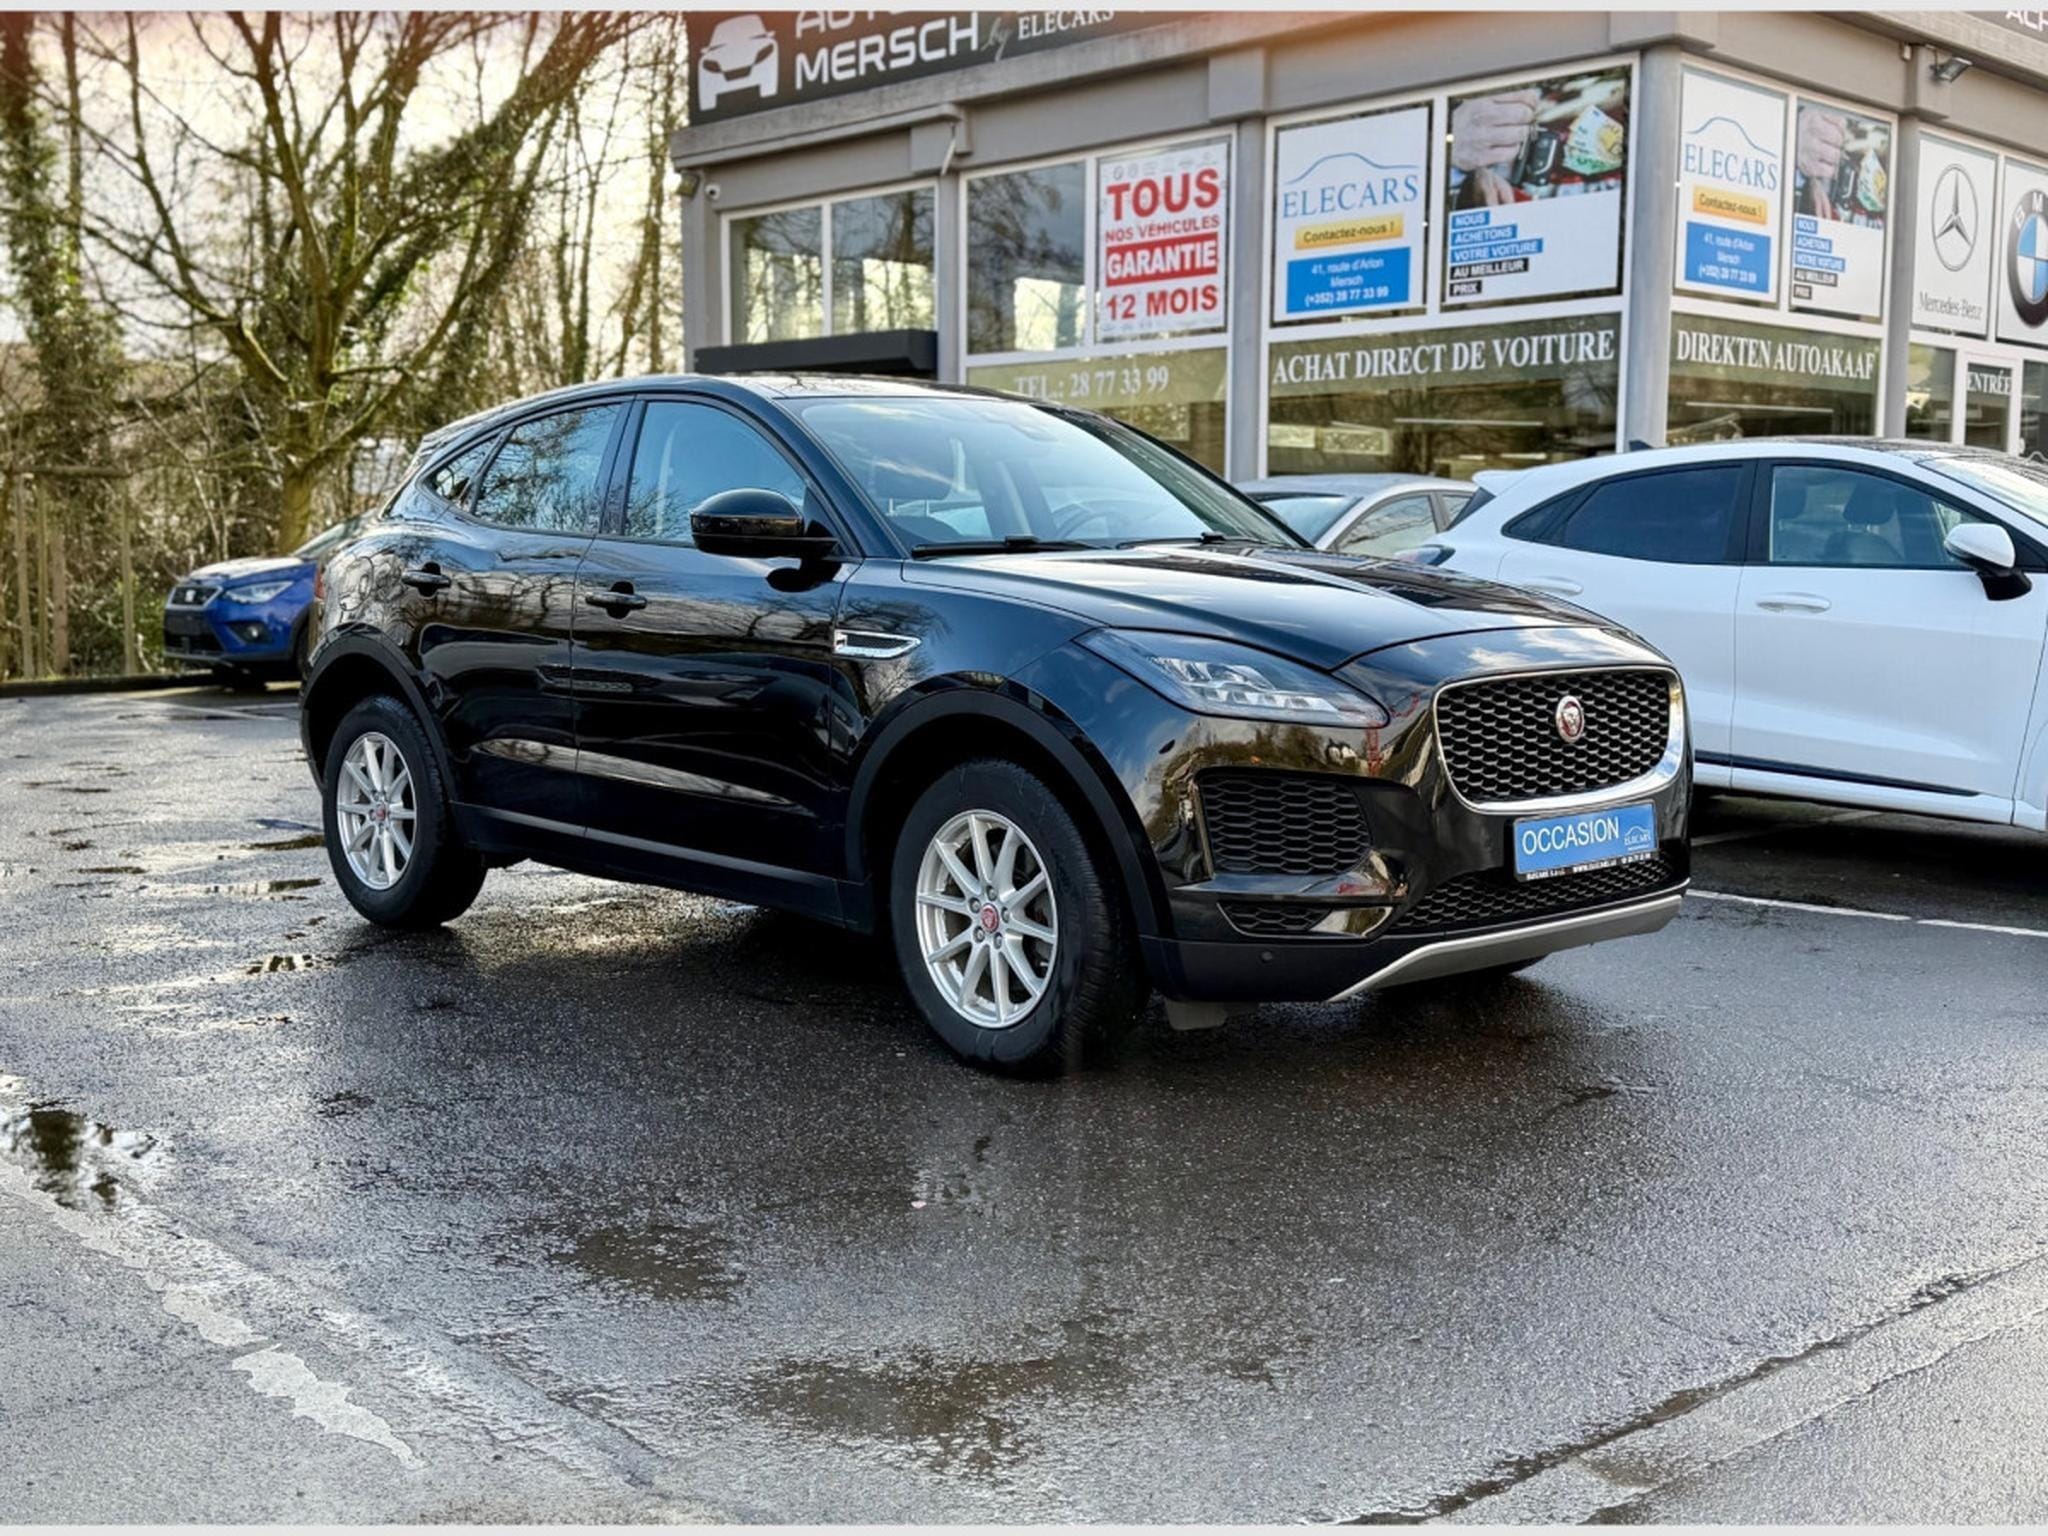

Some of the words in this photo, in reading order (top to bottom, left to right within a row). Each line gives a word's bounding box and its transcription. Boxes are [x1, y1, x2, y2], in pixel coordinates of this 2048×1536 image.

[796, 11, 906, 38] AU
[795, 11, 978, 90] MERSCH
[1684, 143, 1778, 191] ELECARS
[1106, 168, 1220, 221] TOUS
[1283, 174, 1419, 218] ELECARS
[1105, 226, 1134, 242] NOS
[1303, 223, 1387, 243] Contactez-nous
[1455, 213, 1486, 227] NOUS
[1455, 226, 1511, 245] ACHETONS
[1107, 240, 1218, 280] GARANTIE
[1453, 265, 1469, 279] AU
[1470, 259, 1525, 278] MEILLEUR
[1454, 246, 1490, 263] VOTRE
[1491, 241, 1538, 258] VOITURE
[1107, 294, 1136, 320] 12
[1146, 285, 1218, 317] MOIS
[1918, 291, 1983, 320] Mercedes-Benz
[1272, 352, 1350, 385] ACHAT
[1354, 344, 1447, 379] DIRECT
[1451, 341, 1486, 371] DE
[1493, 330, 1615, 368] VOITURE
[1676, 329, 1772, 370] DIREKTEN
[1773, 342, 1876, 380] AUTOAKAAF
[1069, 371, 1091, 398] 28
[1094, 370, 1116, 396] 77
[1120, 367, 1142, 395] 33
[1146, 365, 1169, 393] 99
[1522, 816, 1620, 855] OCCASION
